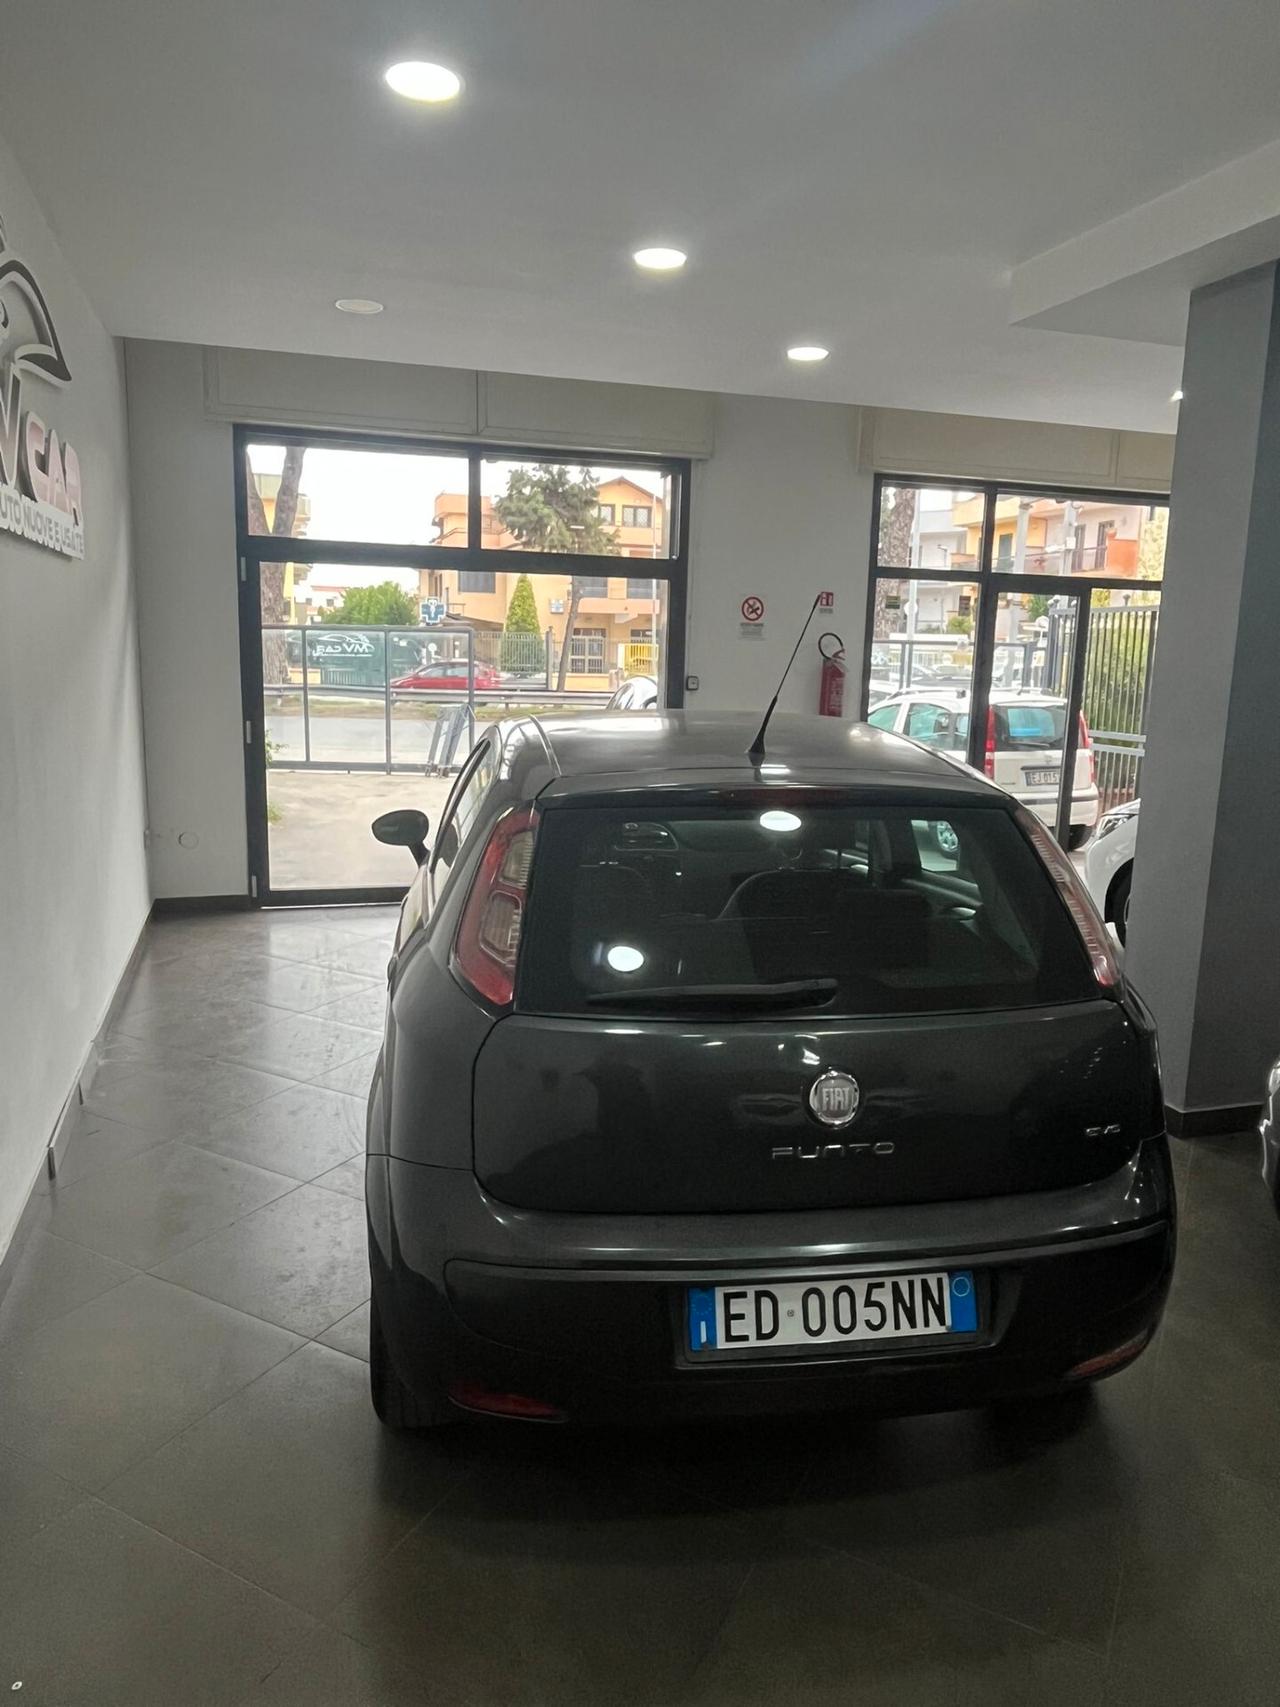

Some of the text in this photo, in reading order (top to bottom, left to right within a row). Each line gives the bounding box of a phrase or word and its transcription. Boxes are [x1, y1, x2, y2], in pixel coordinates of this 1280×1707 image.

[0, 362, 21, 488] V
[823, 1088, 849, 1111] FIAT
[722, 1289, 780, 1343] ED
[801, 1276, 947, 1338] 005NN
